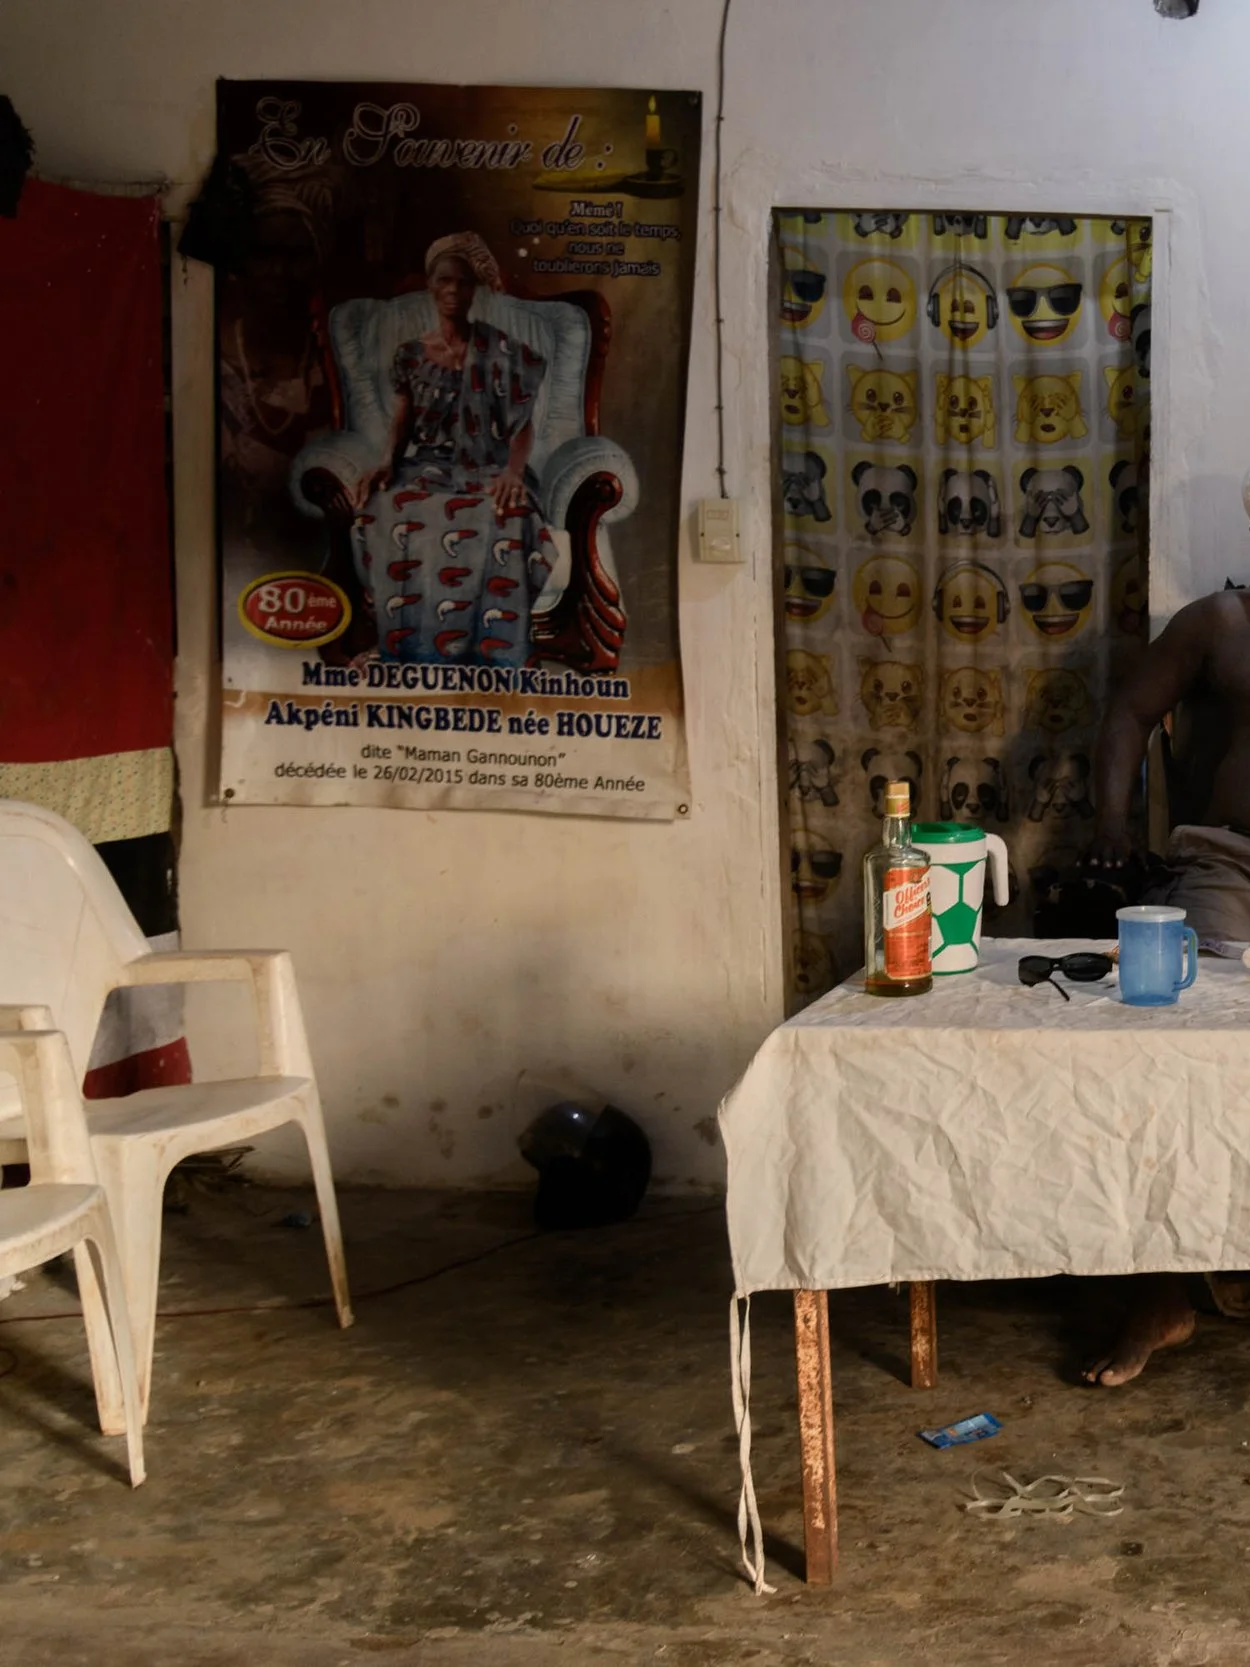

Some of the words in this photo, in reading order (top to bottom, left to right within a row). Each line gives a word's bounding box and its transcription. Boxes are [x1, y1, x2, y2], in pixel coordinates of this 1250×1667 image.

[248, 95, 332, 171] En
[342, 102, 533, 171] Souvenir
[540, 114, 584, 171] de
[511, 220, 543, 236] Quoi
[588, 221, 616, 236] soit
[618, 221, 632, 236] le
[635, 222, 682, 240] temps,
[568, 241, 602, 254] nous
[606, 242, 625, 255] ne
[611, 260, 661, 277] jamais
[264, 615, 328, 632] Année
[302, 661, 360, 687] Mme
[367, 663, 513, 693] DEGUENON
[519, 669, 630, 698] Kinhoun
[264, 700, 360, 731] Akpéni
[366, 704, 502, 733] KINGBEDE
[508, 710, 550, 735] née
[556, 712, 662, 740] HOUEZE
[360, 744, 393, 760] dite
[274, 761, 347, 778] décédée
[352, 764, 368, 779] le
[373, 765, 464, 785] 26/02/2015
[468, 769, 506, 786] dans
[511, 774, 529, 788] sa
[534, 773, 589, 790] 80ème
[593, 775, 646, 792] Année
